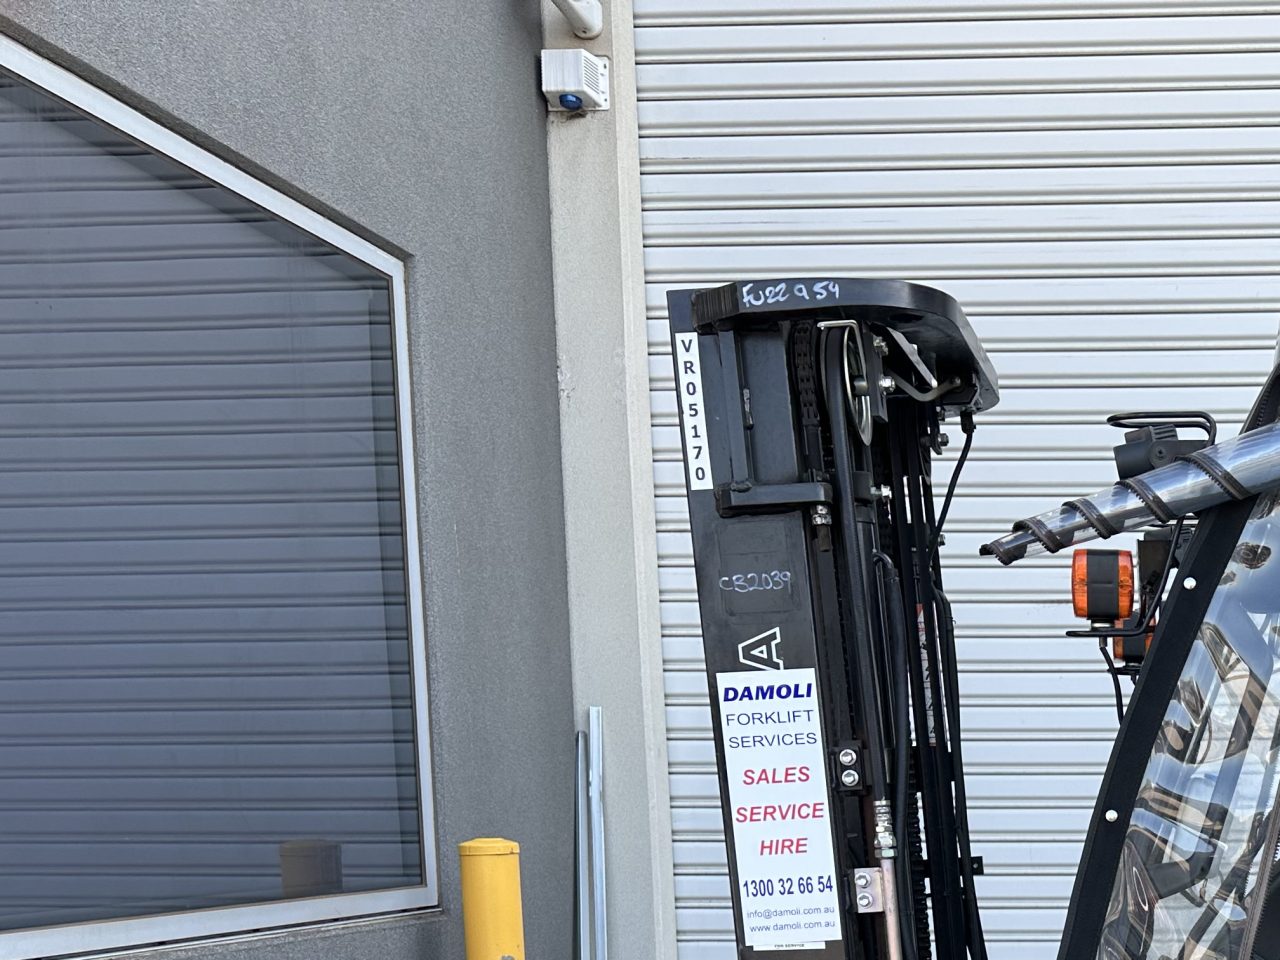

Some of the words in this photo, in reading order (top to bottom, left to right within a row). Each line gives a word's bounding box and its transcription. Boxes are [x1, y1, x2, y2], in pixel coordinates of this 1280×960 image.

[680, 339, 706, 482] VR05170
[723, 683, 813, 702] DAMOLI
[726, 709, 815, 727] FORKLIFT
[728, 732, 818, 749] SERVICES
[742, 766, 810, 786] SALES
[735, 802, 825, 823] SERVICE
[759, 837, 809, 856] HIRE
[743, 878, 775, 898] 1300
[778, 877, 795, 896] 32
[797, 876, 814, 894] 66
[818, 875, 834, 893] 54
